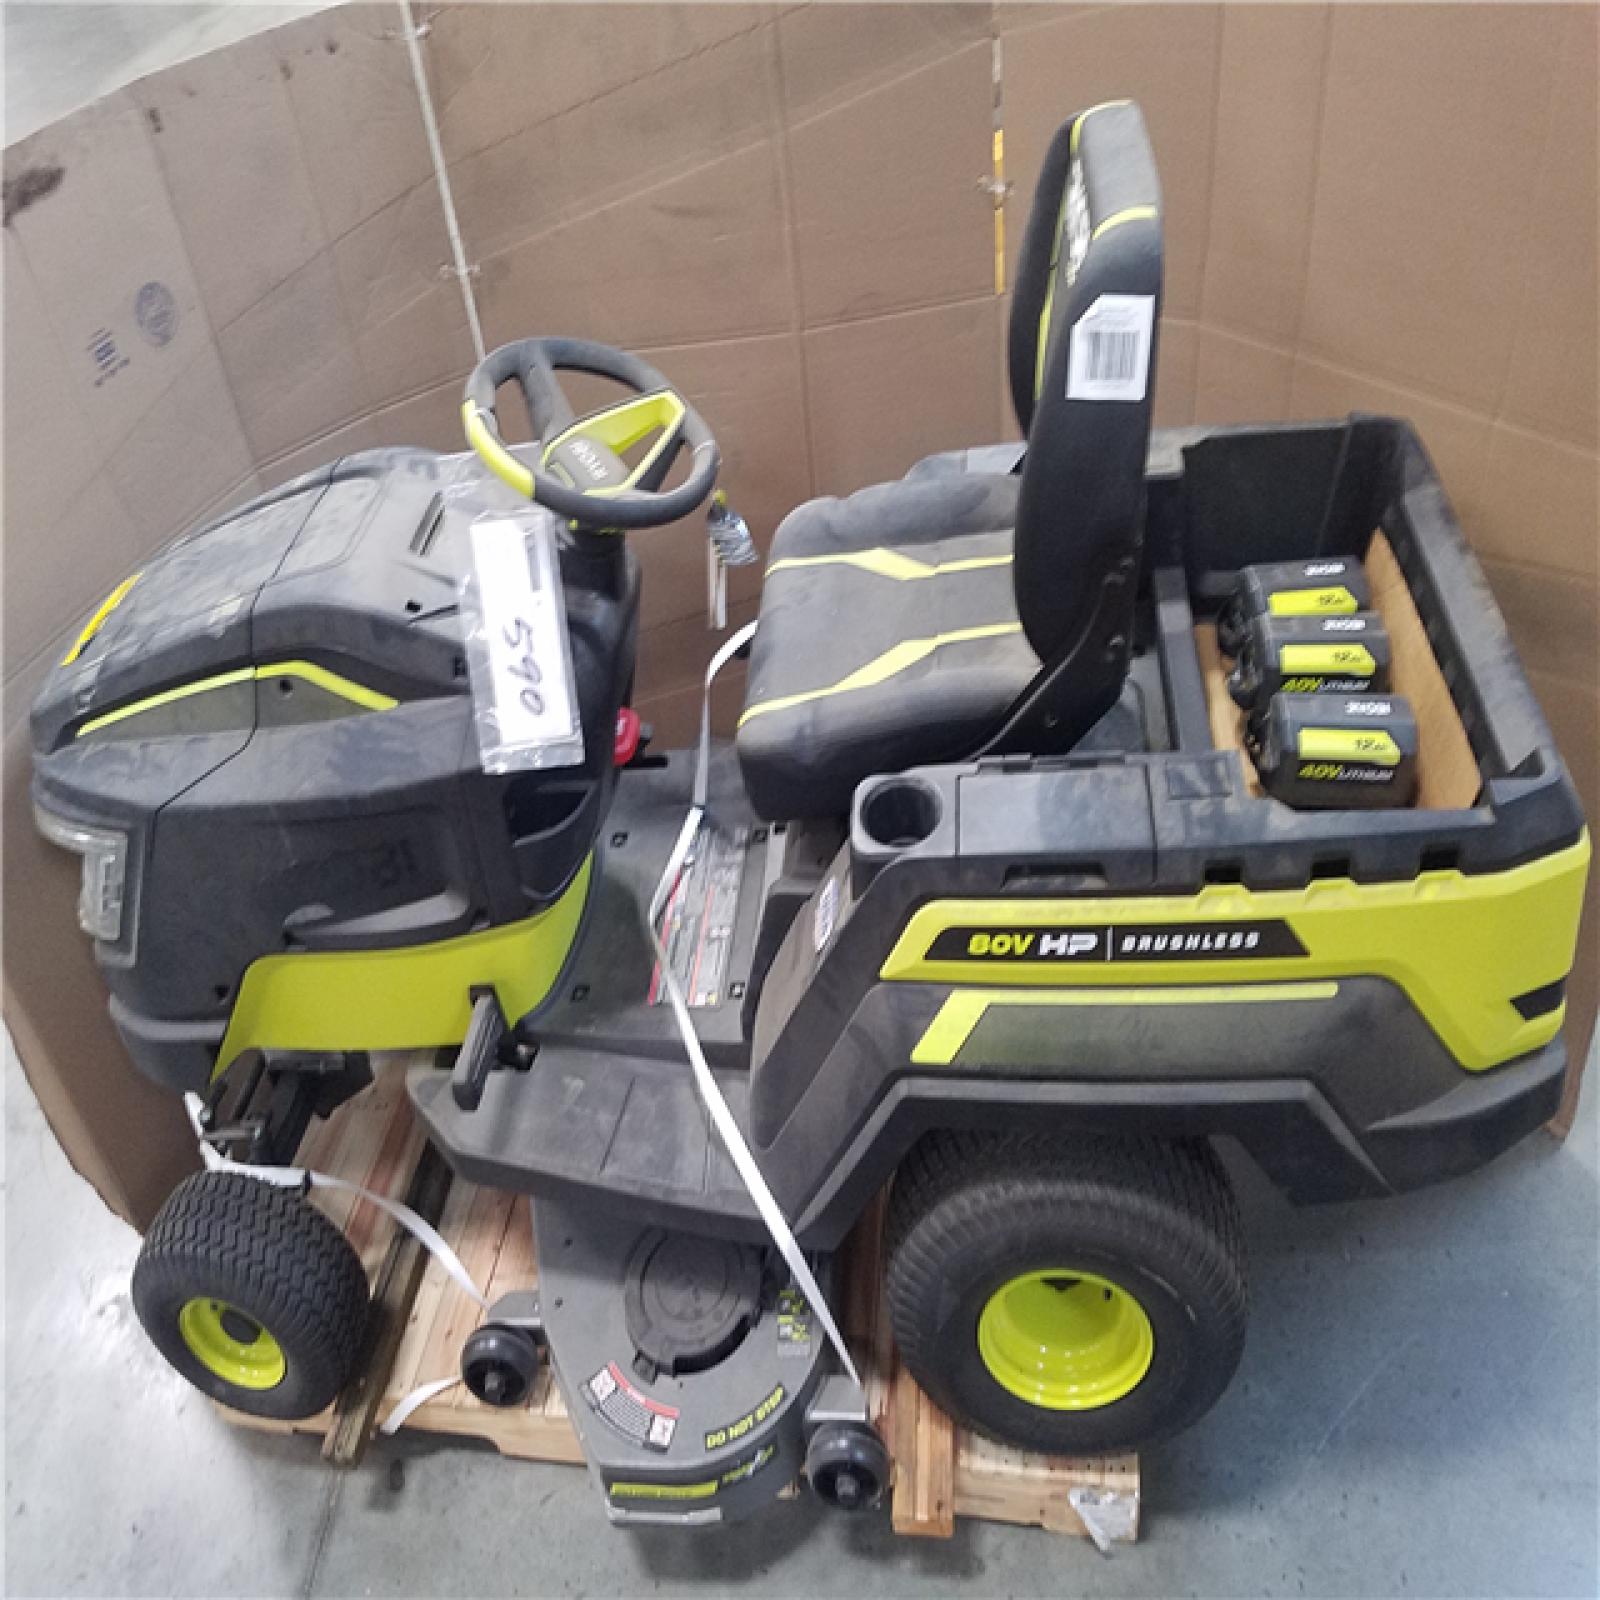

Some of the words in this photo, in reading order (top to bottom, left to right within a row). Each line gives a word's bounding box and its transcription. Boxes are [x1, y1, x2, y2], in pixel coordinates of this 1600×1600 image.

[967, 933, 1034, 956] 80V
[1039, 933, 1099, 956] HP
[1120, 931, 1261, 953] BRUSHLESS
[706, 1430, 727, 1449] DO
